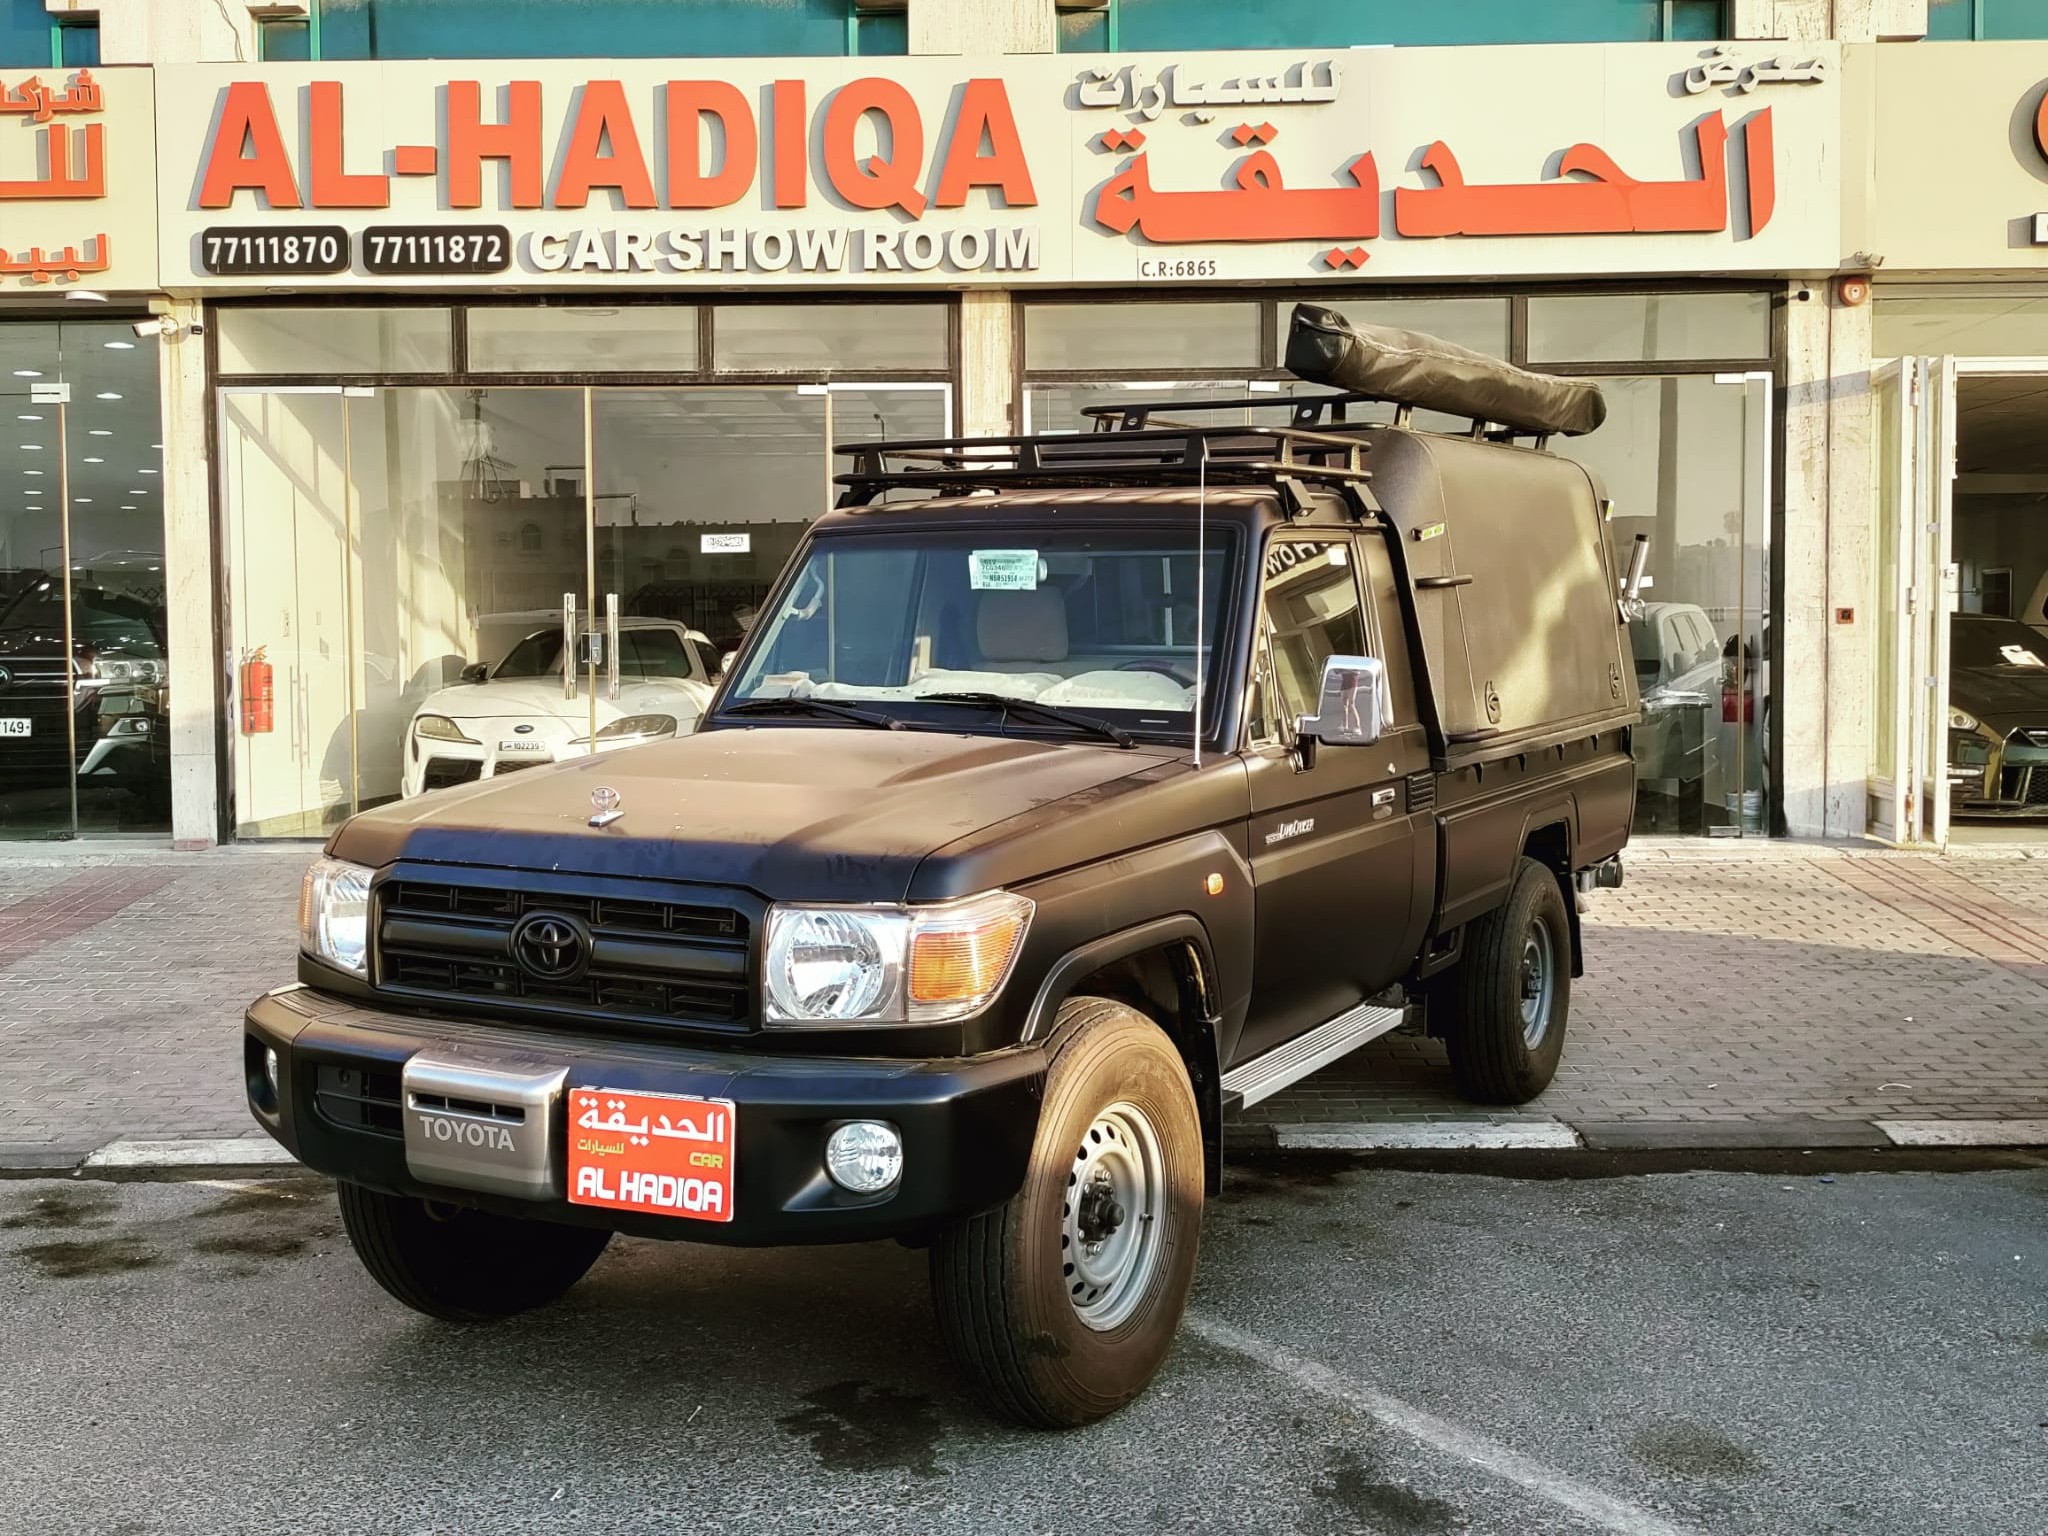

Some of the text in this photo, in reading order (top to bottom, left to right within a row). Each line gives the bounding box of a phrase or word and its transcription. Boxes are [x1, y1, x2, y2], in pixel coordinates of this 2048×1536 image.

[1079, 60, 1342, 121] للسيارات
[1685, 47, 1824, 94] معرض
[198, 77, 1039, 220] AL-HADIQA
[1095, 104, 1776, 271] الحديقة
[207, 235, 338, 265] 77111870
[370, 235, 502, 265] 77111872
[528, 227, 657, 271] CAR
[1141, 260, 1217, 277] C.R:6865
[419, 1116, 516, 1152] TOYOTA
[577, 1096, 725, 1147] الحديقة
[577, 1138, 625, 1156] للسيارات
[689, 1151, 724, 1169] CAR
[577, 1166, 723, 1213] AL HADIQA
